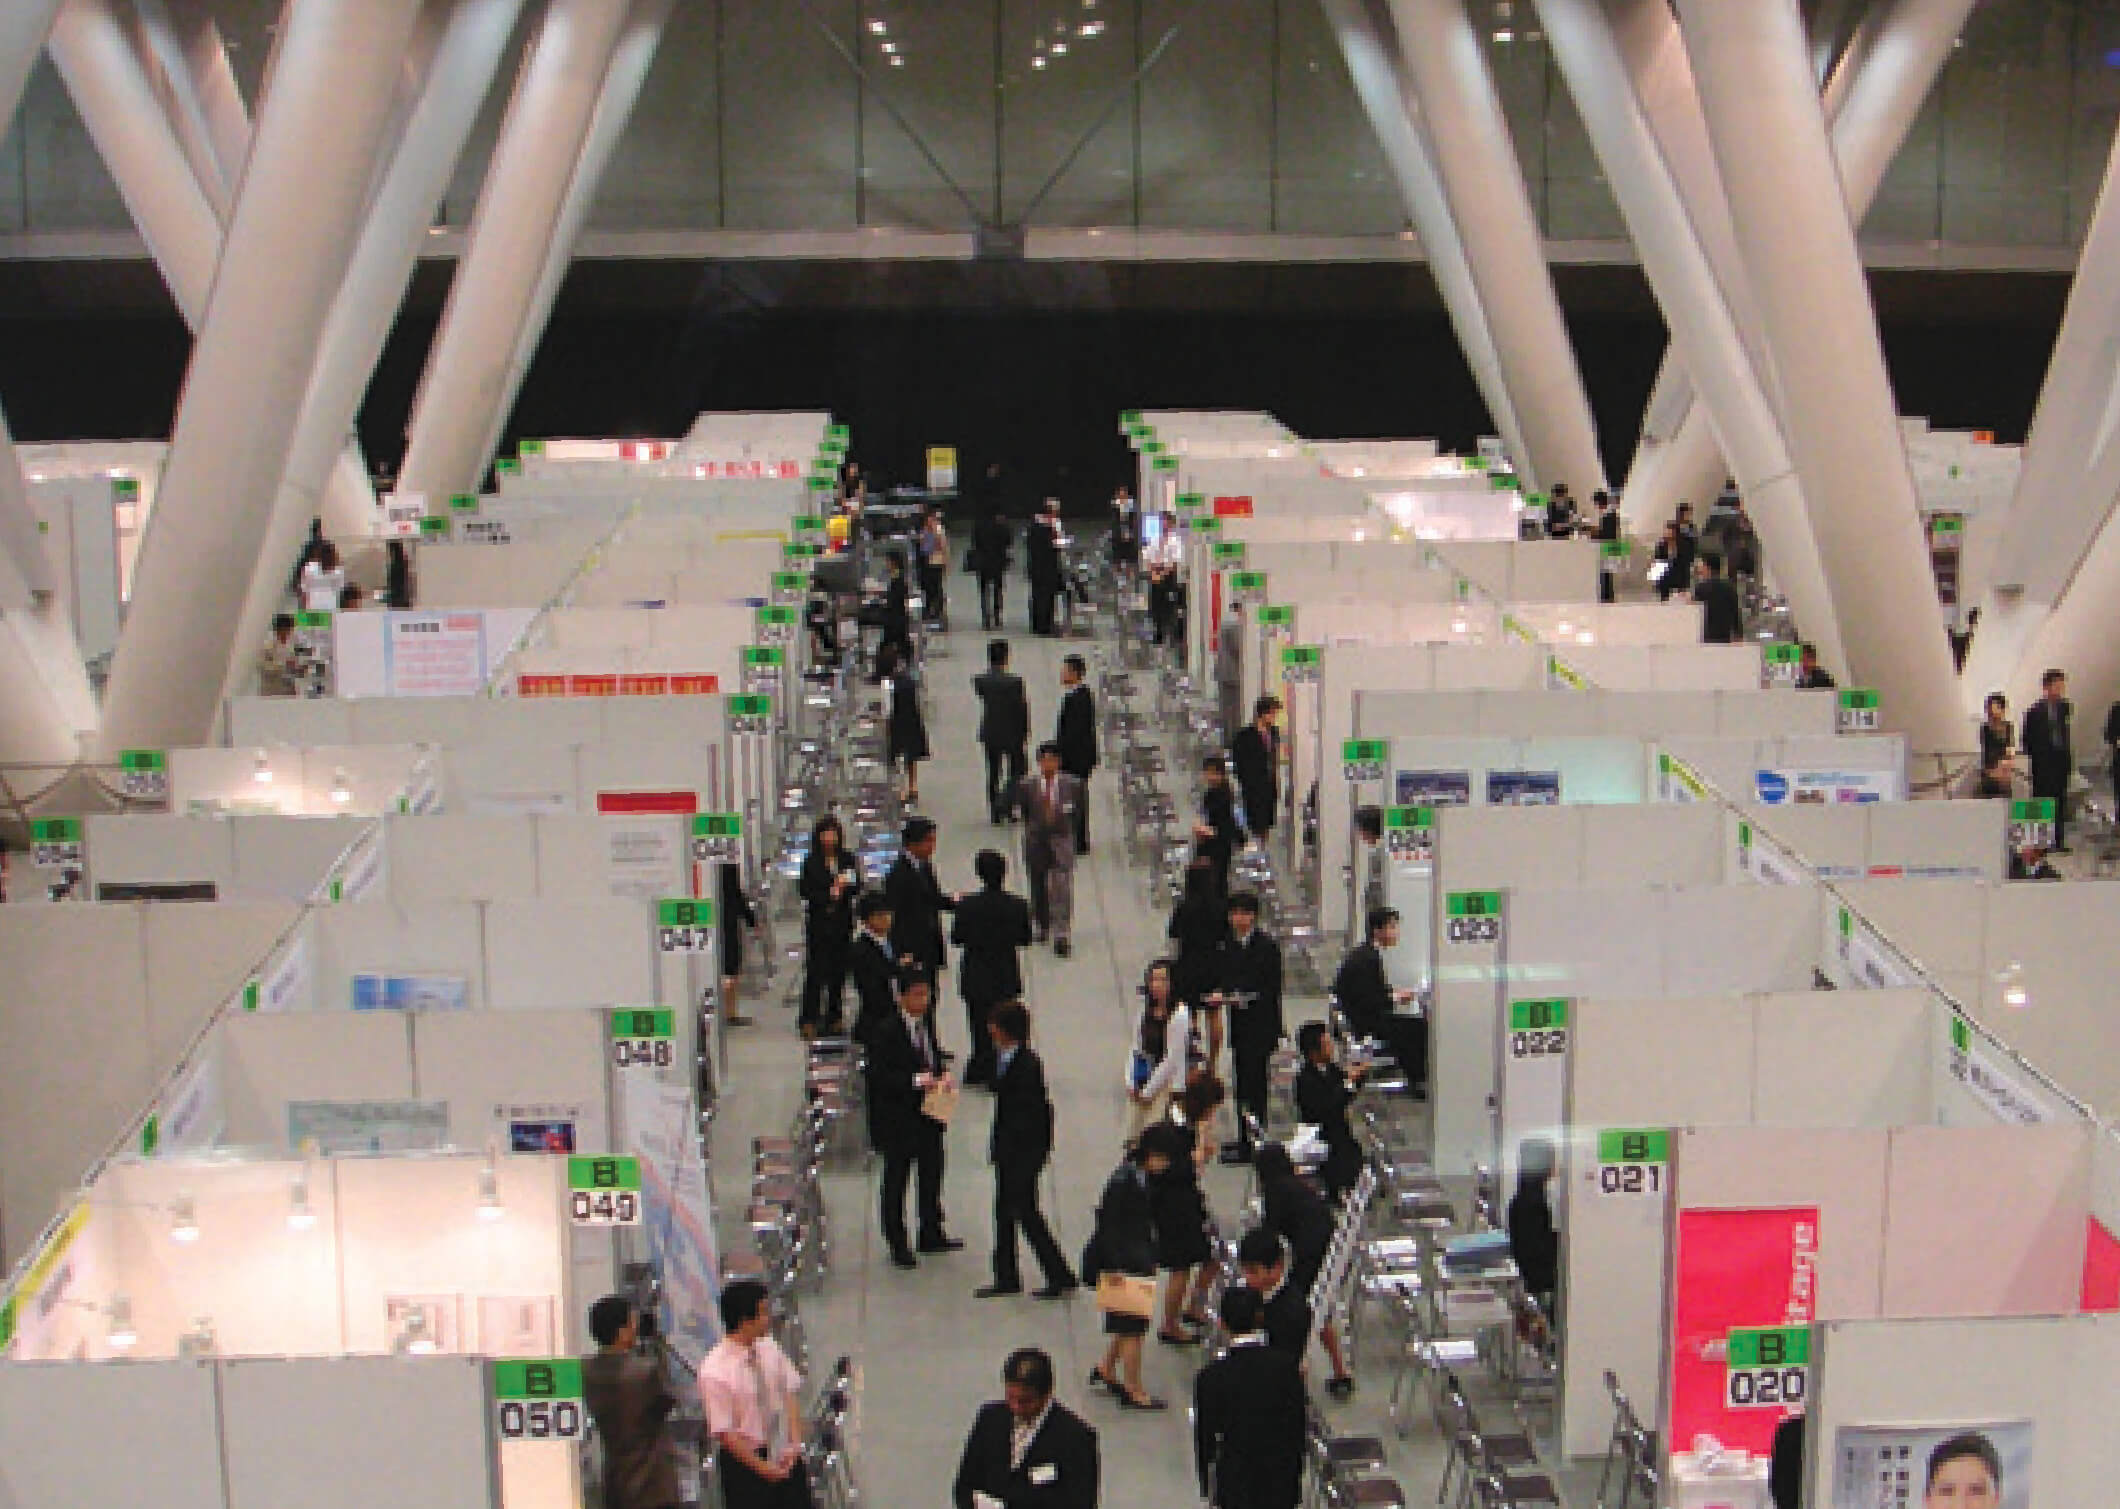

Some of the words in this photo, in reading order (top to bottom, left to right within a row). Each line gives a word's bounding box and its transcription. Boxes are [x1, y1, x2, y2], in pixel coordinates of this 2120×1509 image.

[1388, 829, 1433, 851] 024
[677, 903, 694, 924] B
[659, 928, 709, 951] 047
[1446, 917, 1498, 940] 023
[632, 1010, 654, 1037] B
[1530, 1001, 1551, 1029] B
[615, 1040, 669, 1066] 048
[1513, 1031, 1565, 1058] 022
[1622, 1135, 1648, 1159] B
[593, 1160, 618, 1187] B
[1601, 1165, 1659, 1192] 021
[572, 1191, 634, 1222] 049
[1759, 1333, 1785, 1364] B
[525, 1363, 556, 1395] B
[1730, 1367, 1804, 1403] 020
[500, 1401, 579, 1437] 050
